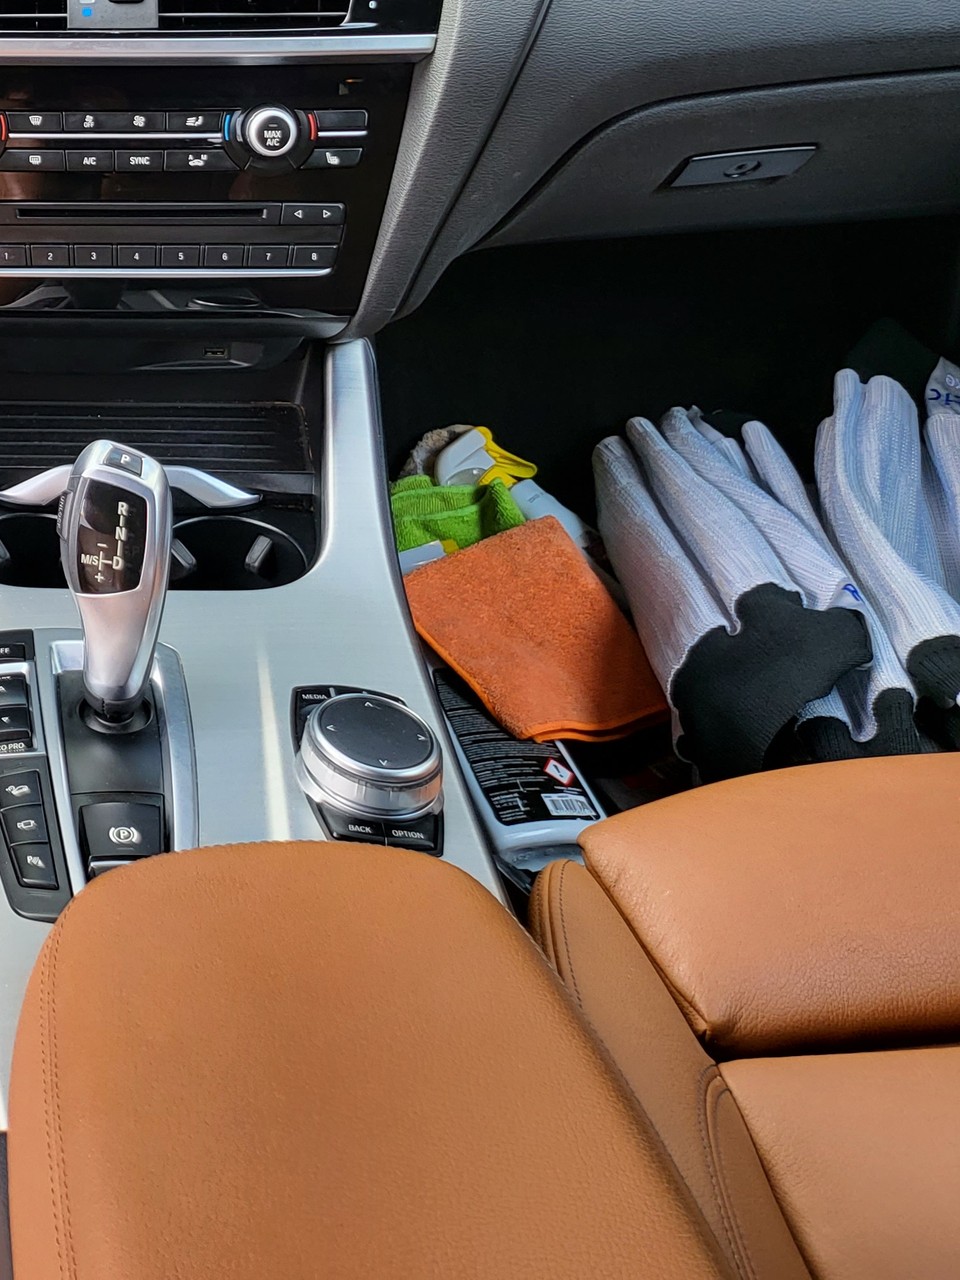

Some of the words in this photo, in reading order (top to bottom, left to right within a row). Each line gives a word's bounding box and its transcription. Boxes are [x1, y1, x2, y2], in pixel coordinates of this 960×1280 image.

[263, 130, 282, 139] MAX
[265, 138, 280, 147] A/C
[82, 156, 97, 165] A/C
[129, 156, 150, 165] SYNC
[4, 252, 9, 260] 1
[47, 252, 53, 261] 2
[90, 252, 97, 261] 3
[133, 252, 140, 261] 4
[178, 252, 184, 261] 5
[221, 252, 228, 261] 6
[266, 252, 272, 261] 7
[311, 252, 318, 261] 8
[120, 453, 131, 464] P
[117, 501, 129, 516] R
[115, 526, 127, 541] N
[80, 553, 98, 565] M/S
[112, 556, 124, 570] D
[8, 742, 25, 751] PRO
[348, 824, 372, 833] BACK
[391, 829, 425, 839] OPTION
